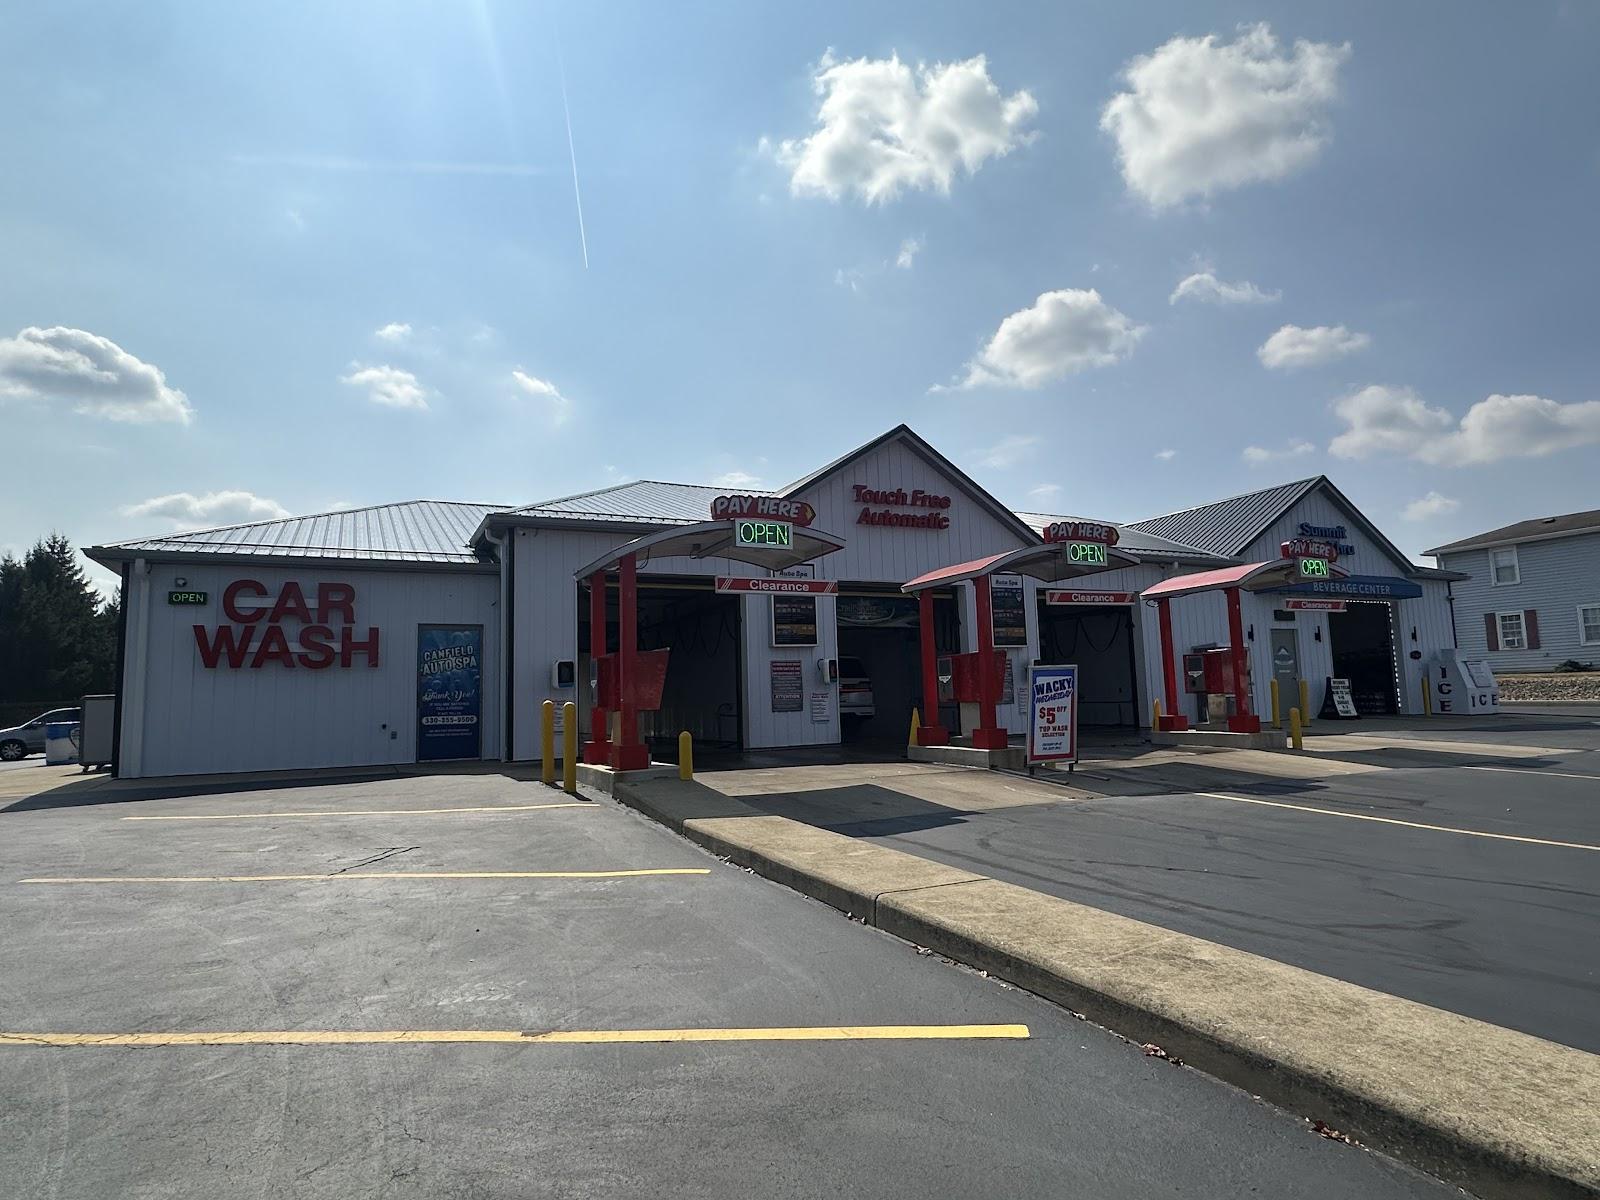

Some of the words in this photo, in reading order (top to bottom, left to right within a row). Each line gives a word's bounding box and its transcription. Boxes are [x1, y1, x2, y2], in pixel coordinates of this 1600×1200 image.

[853, 484, 908, 505] Touch
[911, 490, 951, 508] Free
[716, 496, 751, 515] PAY
[757, 499, 801, 517] HERE
[856, 507, 950, 529] Automatic
[740, 523, 788, 545] OPEN
[1049, 523, 1076, 538] PAY
[1078, 524, 1110, 540] HERE
[1300, 522, 1347, 539] Summit
[1070, 544, 1104, 562] OPEN
[1288, 541, 1306, 554] PAY
[1308, 543, 1331, 556] HERE
[1302, 559, 1327, 575] OPEN
[749, 580, 810, 592] Clearance
[1313, 582, 1358, 594] BEVERAGE
[1358, 584, 1391, 595] CENTER
[173, 593, 204, 603] OPEN
[223, 579, 356, 624] CAR
[1071, 593, 1115, 602] Clearance
[1301, 601, 1332, 609] Clearance
[192, 624, 379, 669] WASH
[424, 645, 474, 661] CANFIELD
[1035, 678, 1072, 696] WACKY
[1438, 665, 1452, 712] ICE
[1471, 694, 1498, 707] ICE
[1039, 706, 1056, 724] $5
